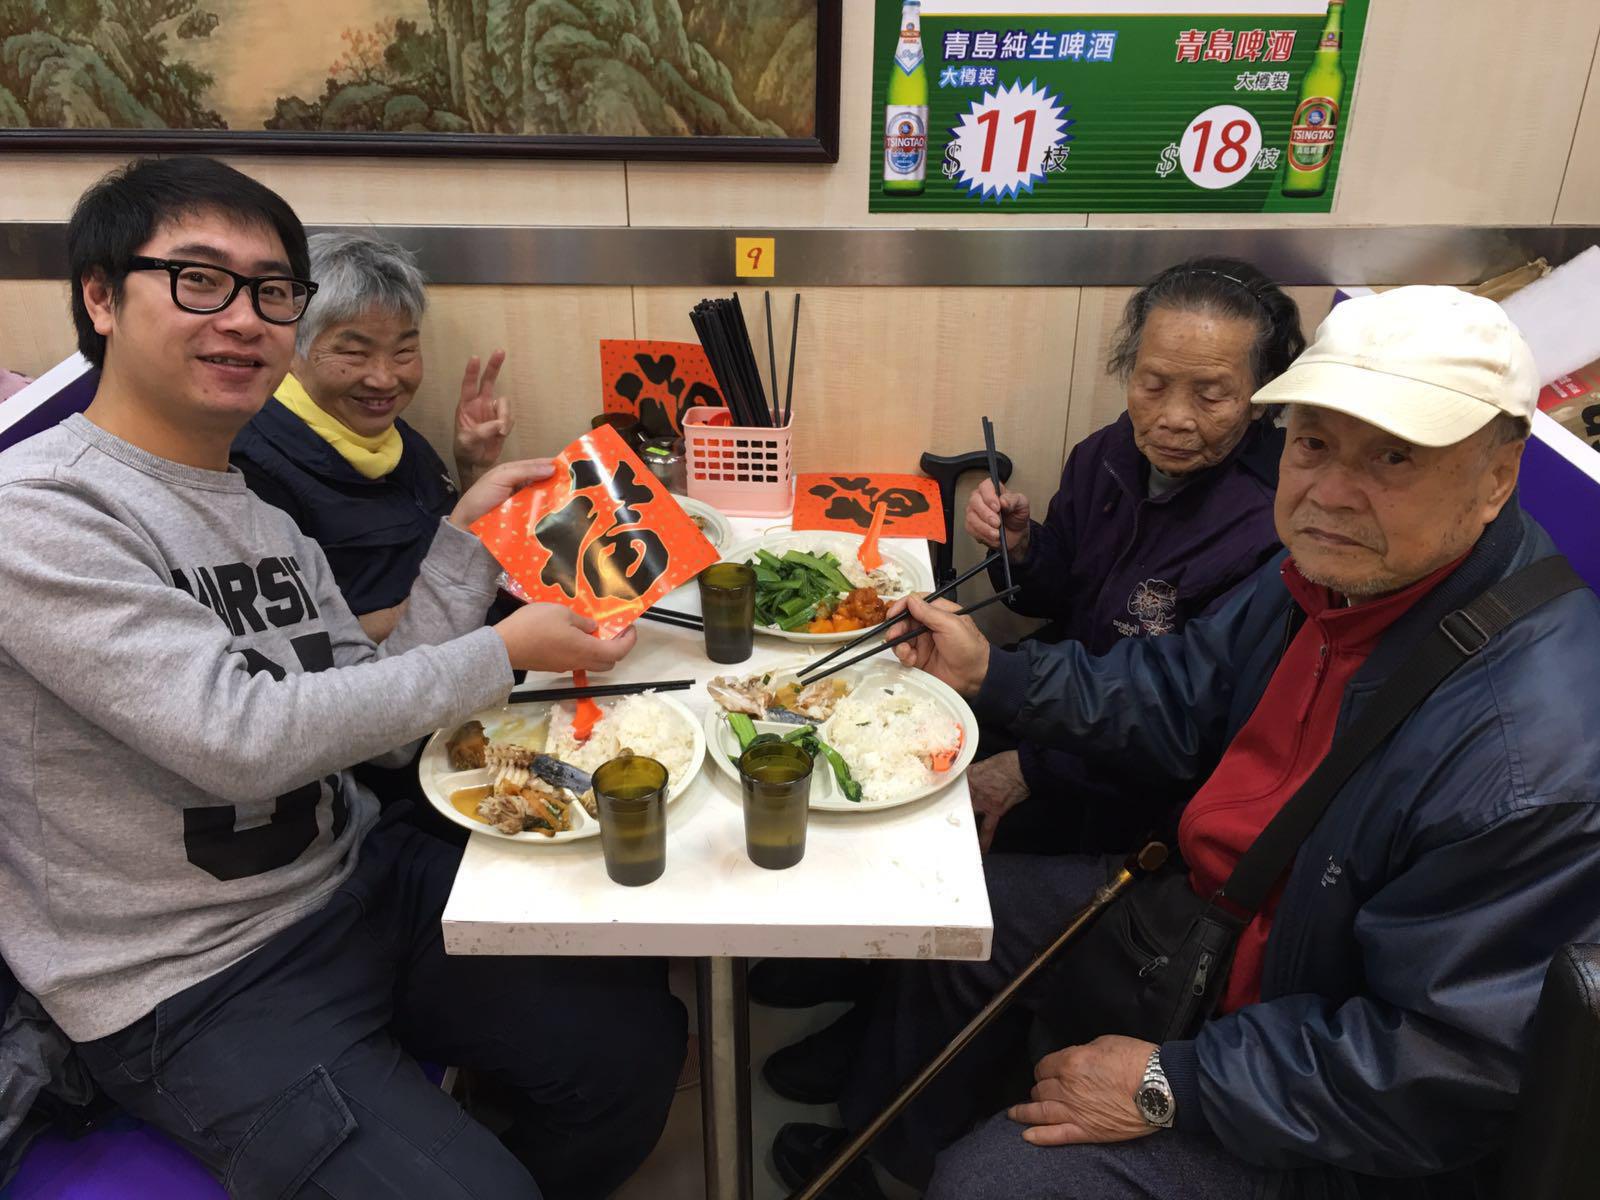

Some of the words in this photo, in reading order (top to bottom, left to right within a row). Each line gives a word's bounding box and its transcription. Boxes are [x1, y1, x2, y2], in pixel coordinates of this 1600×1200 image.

[944, 31, 1116, 59] 青島純生啤酒
[1175, 29, 1296, 62] 青島啤酒
[940, 68, 996, 86] 大樽裝
[1234, 71, 1290, 90] 大樽裝
[886, 137, 925, 147] TSINGTAO
[1294, 130, 1334, 140] TSINGTAO
[747, 247, 762, 269] 9
[535, 459, 669, 600] 福
